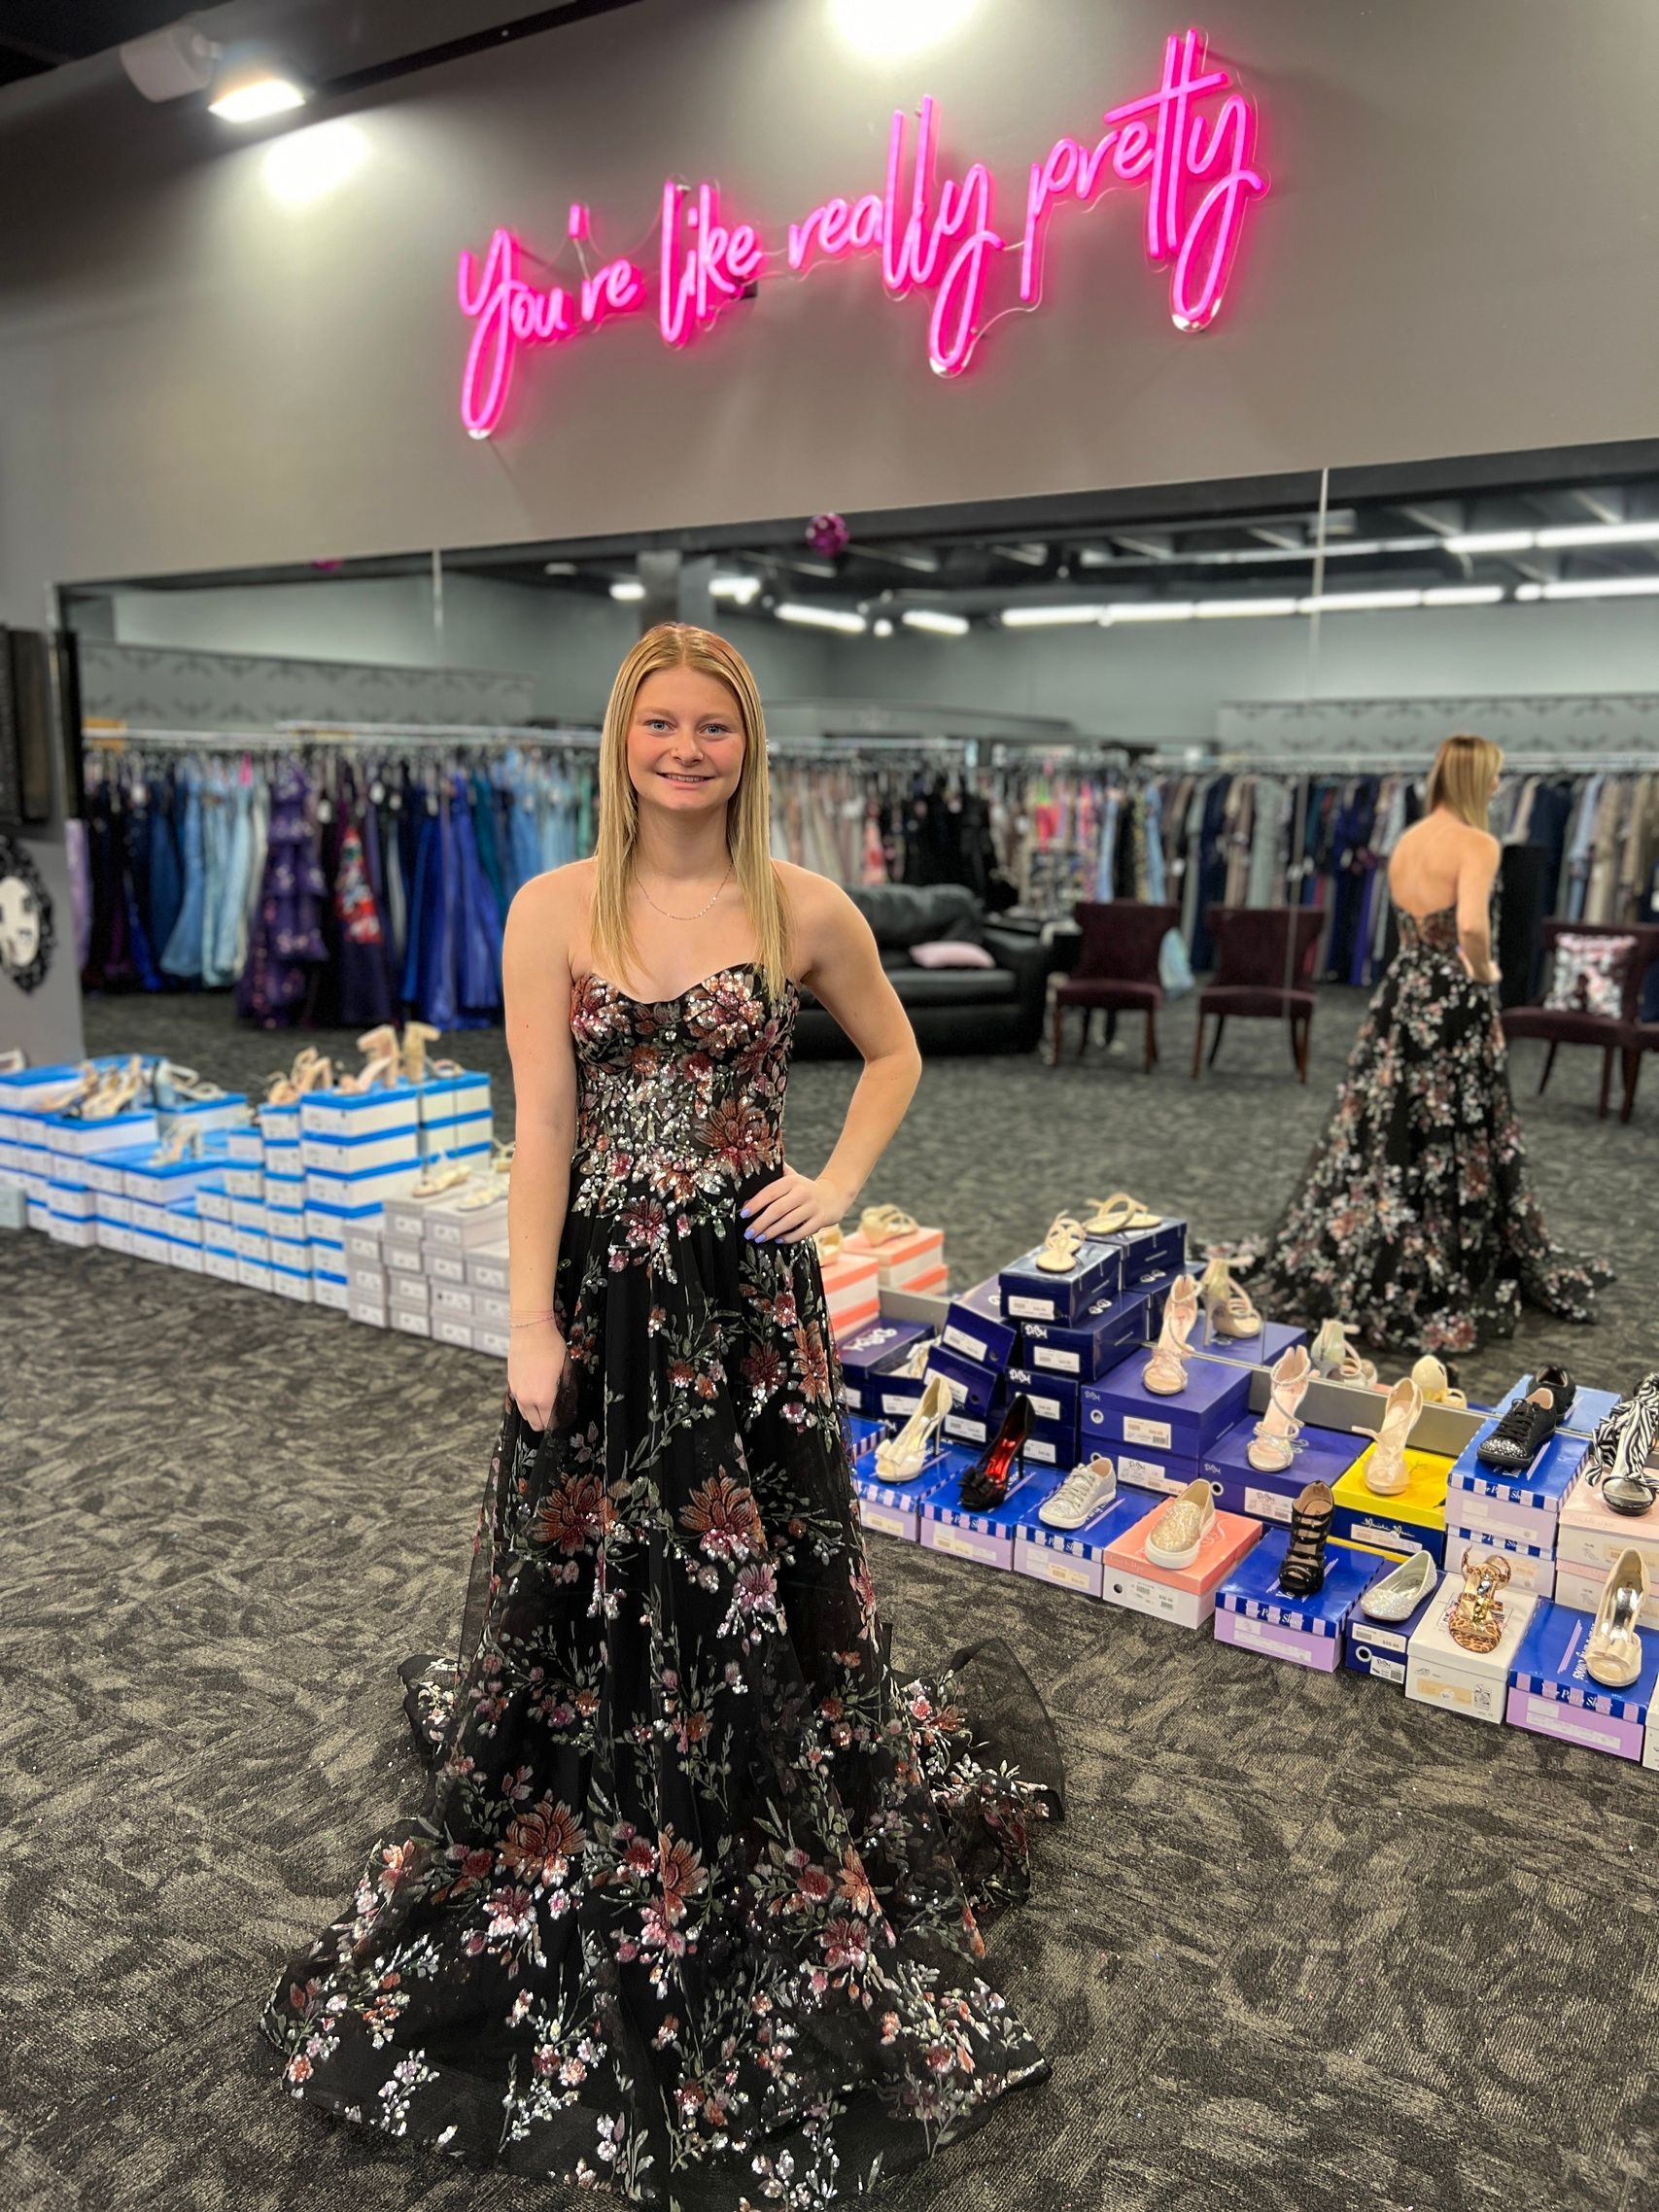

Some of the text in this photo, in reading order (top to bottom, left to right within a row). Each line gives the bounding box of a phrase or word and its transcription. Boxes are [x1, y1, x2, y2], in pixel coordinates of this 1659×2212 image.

[459, 28, 1262, 432] You're like really pretty
